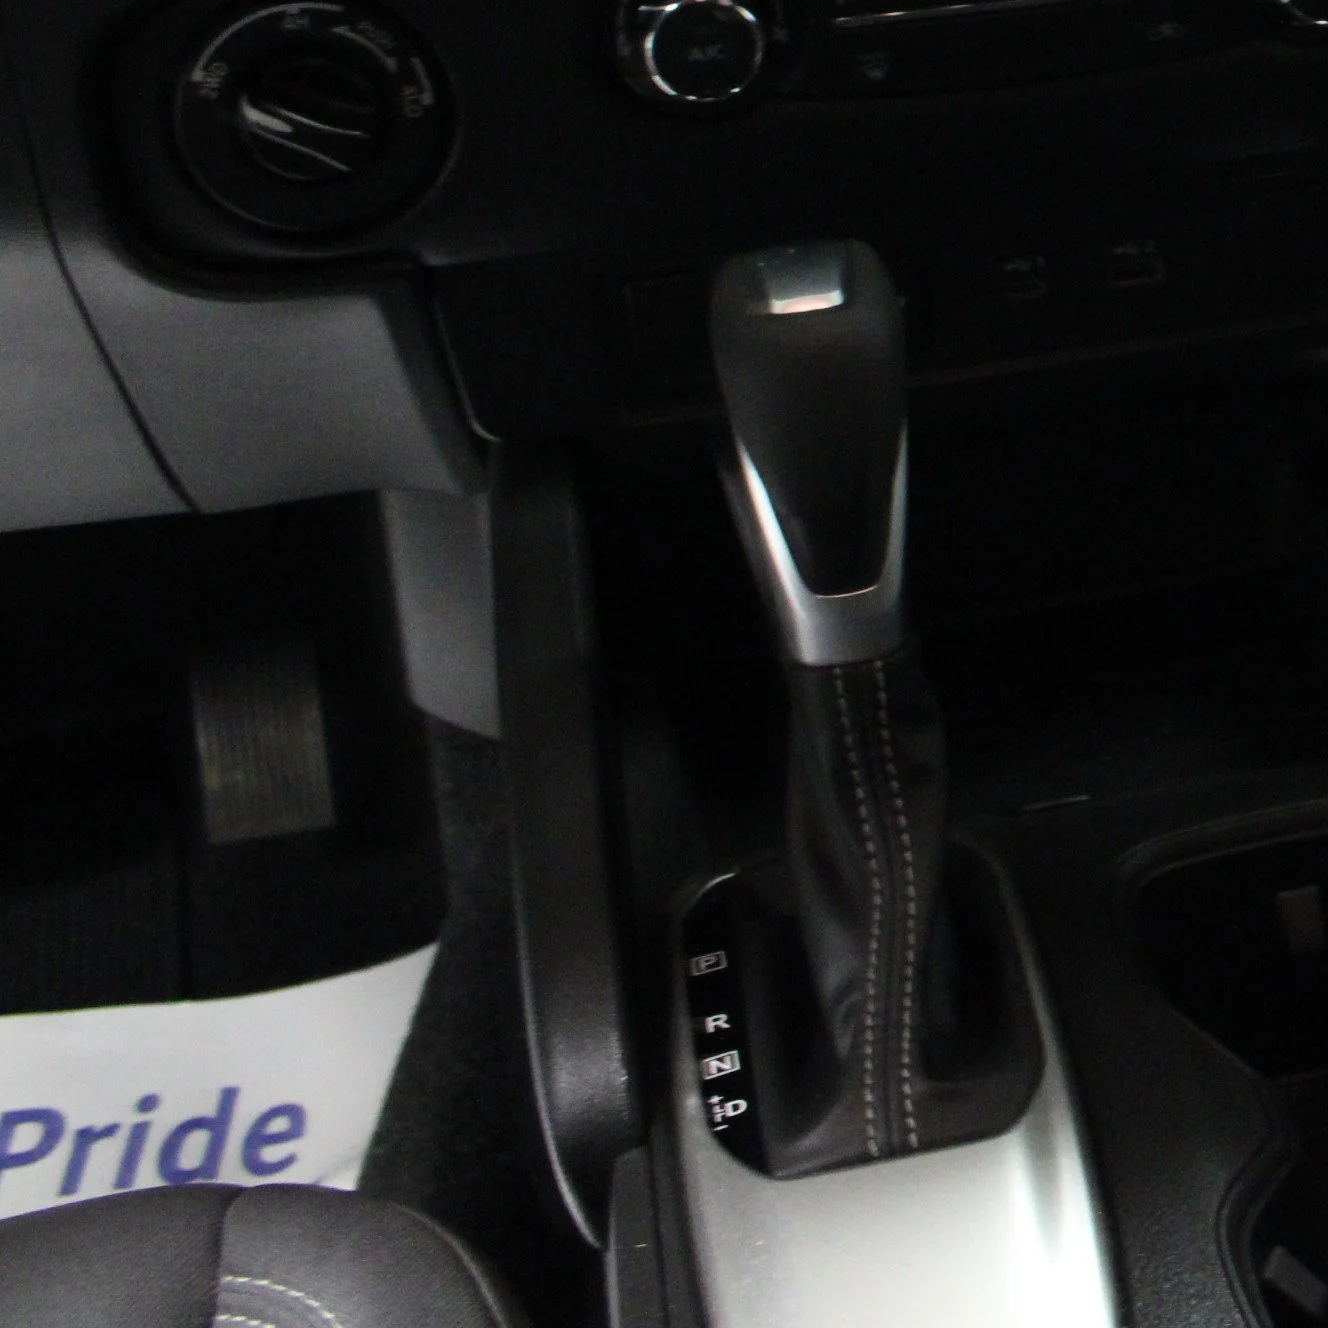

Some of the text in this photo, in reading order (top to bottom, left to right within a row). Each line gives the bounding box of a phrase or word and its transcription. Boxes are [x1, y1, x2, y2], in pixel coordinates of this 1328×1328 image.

[704, 1013, 731, 1033] R
[708, 1055, 733, 1075] N
[723, 1099, 748, 1118] D
[0, 1085, 308, 1197] Pride
